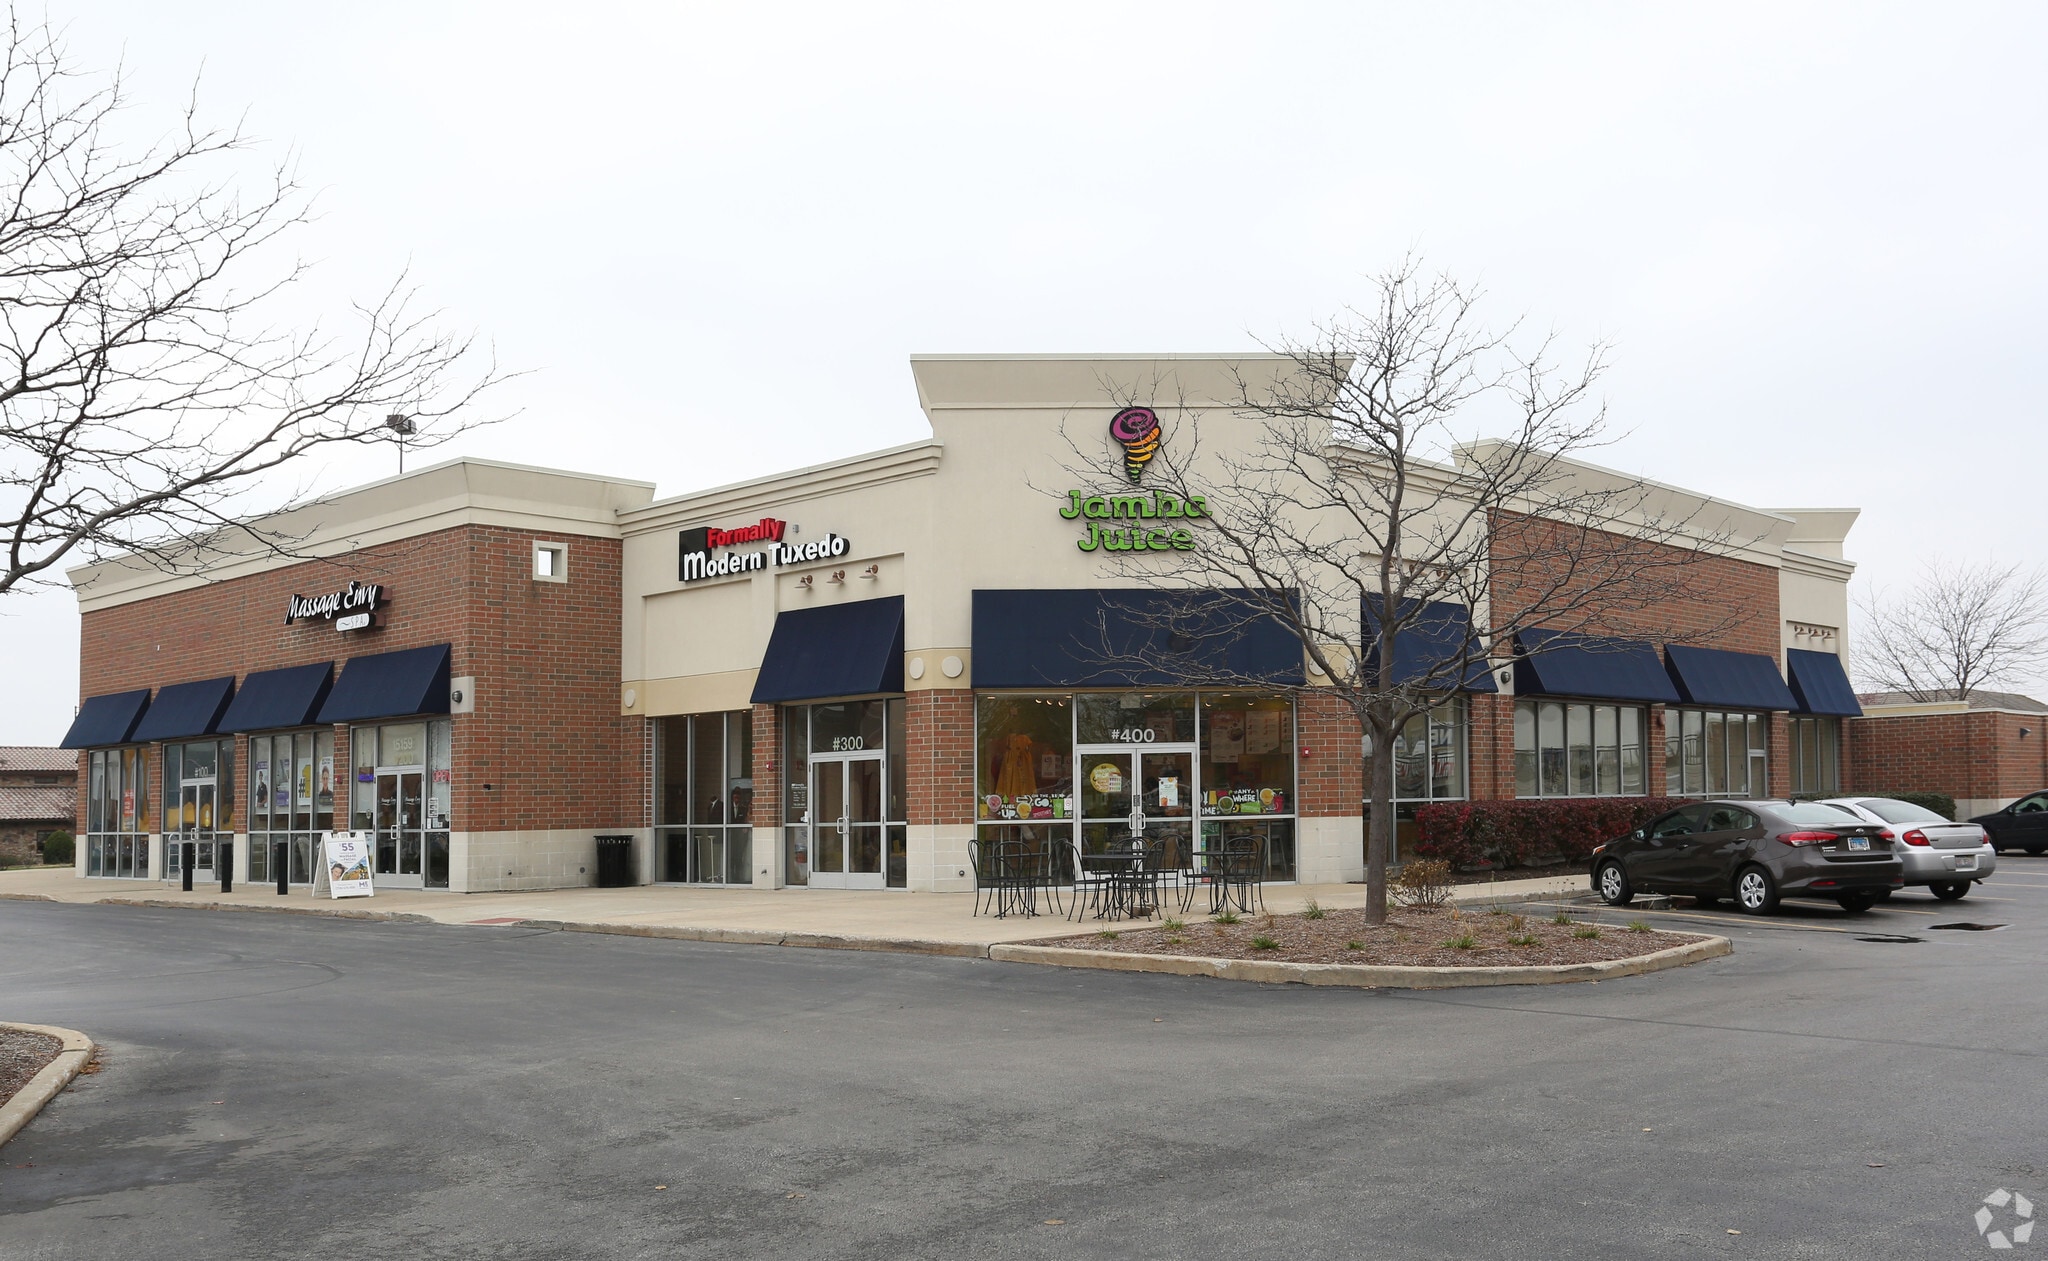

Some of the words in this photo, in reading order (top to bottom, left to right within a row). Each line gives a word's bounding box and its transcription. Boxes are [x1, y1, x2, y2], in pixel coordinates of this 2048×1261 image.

[1059, 490, 1212, 519] Jamba
[707, 518, 786, 549] Formally
[1077, 521, 1196, 551] Juice
[684, 550, 761, 581] Modern
[768, 533, 844, 566] Tuxedo
[284, 592, 340, 624] Massage
[344, 581, 377, 611] Envy
[1111, 728, 1155, 742] #400
[393, 737, 413, 751] 15159
[832, 735, 864, 751] #300
[194, 766, 209, 777] #100
[1034, 798, 1050, 807] GO
[1232, 794, 1256, 803] WHERE
[1001, 808, 1016, 819] UP
